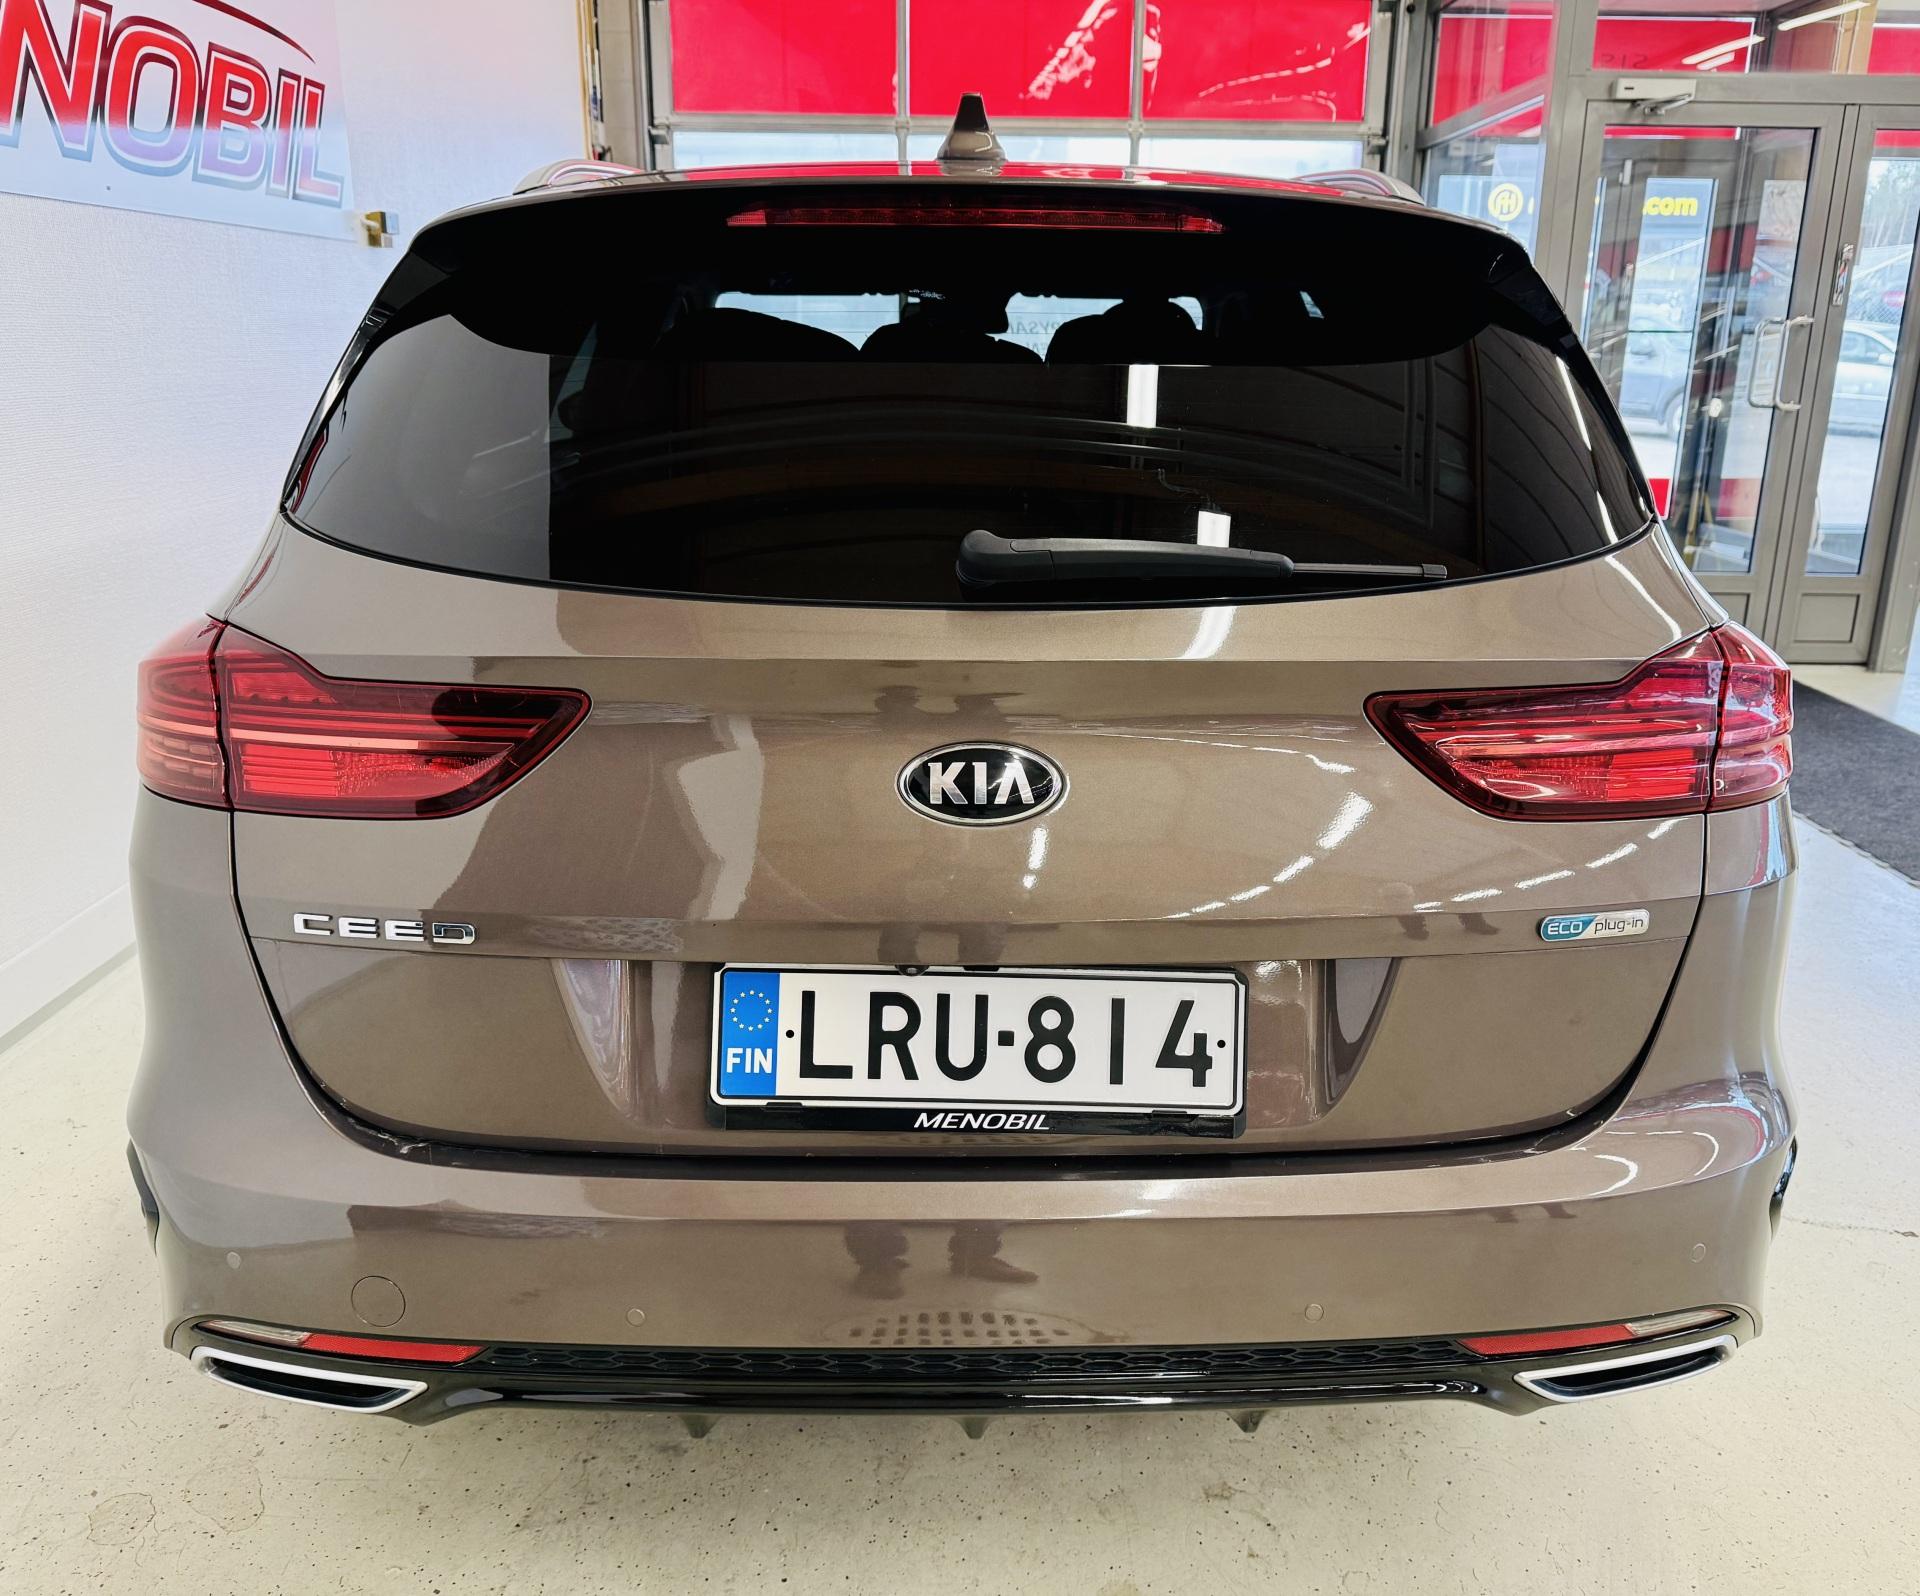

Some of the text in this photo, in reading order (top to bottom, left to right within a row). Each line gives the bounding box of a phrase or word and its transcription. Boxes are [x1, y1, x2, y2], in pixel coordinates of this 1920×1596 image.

[928, 760, 1035, 805] KIA
[294, 913, 476, 945] CEED
[1547, 916, 1645, 935] ECO plug-in
[800, 989, 1214, 1089] LRU-814
[726, 1047, 773, 1074] FIN
[913, 1112, 1050, 1131] MENOBIL
